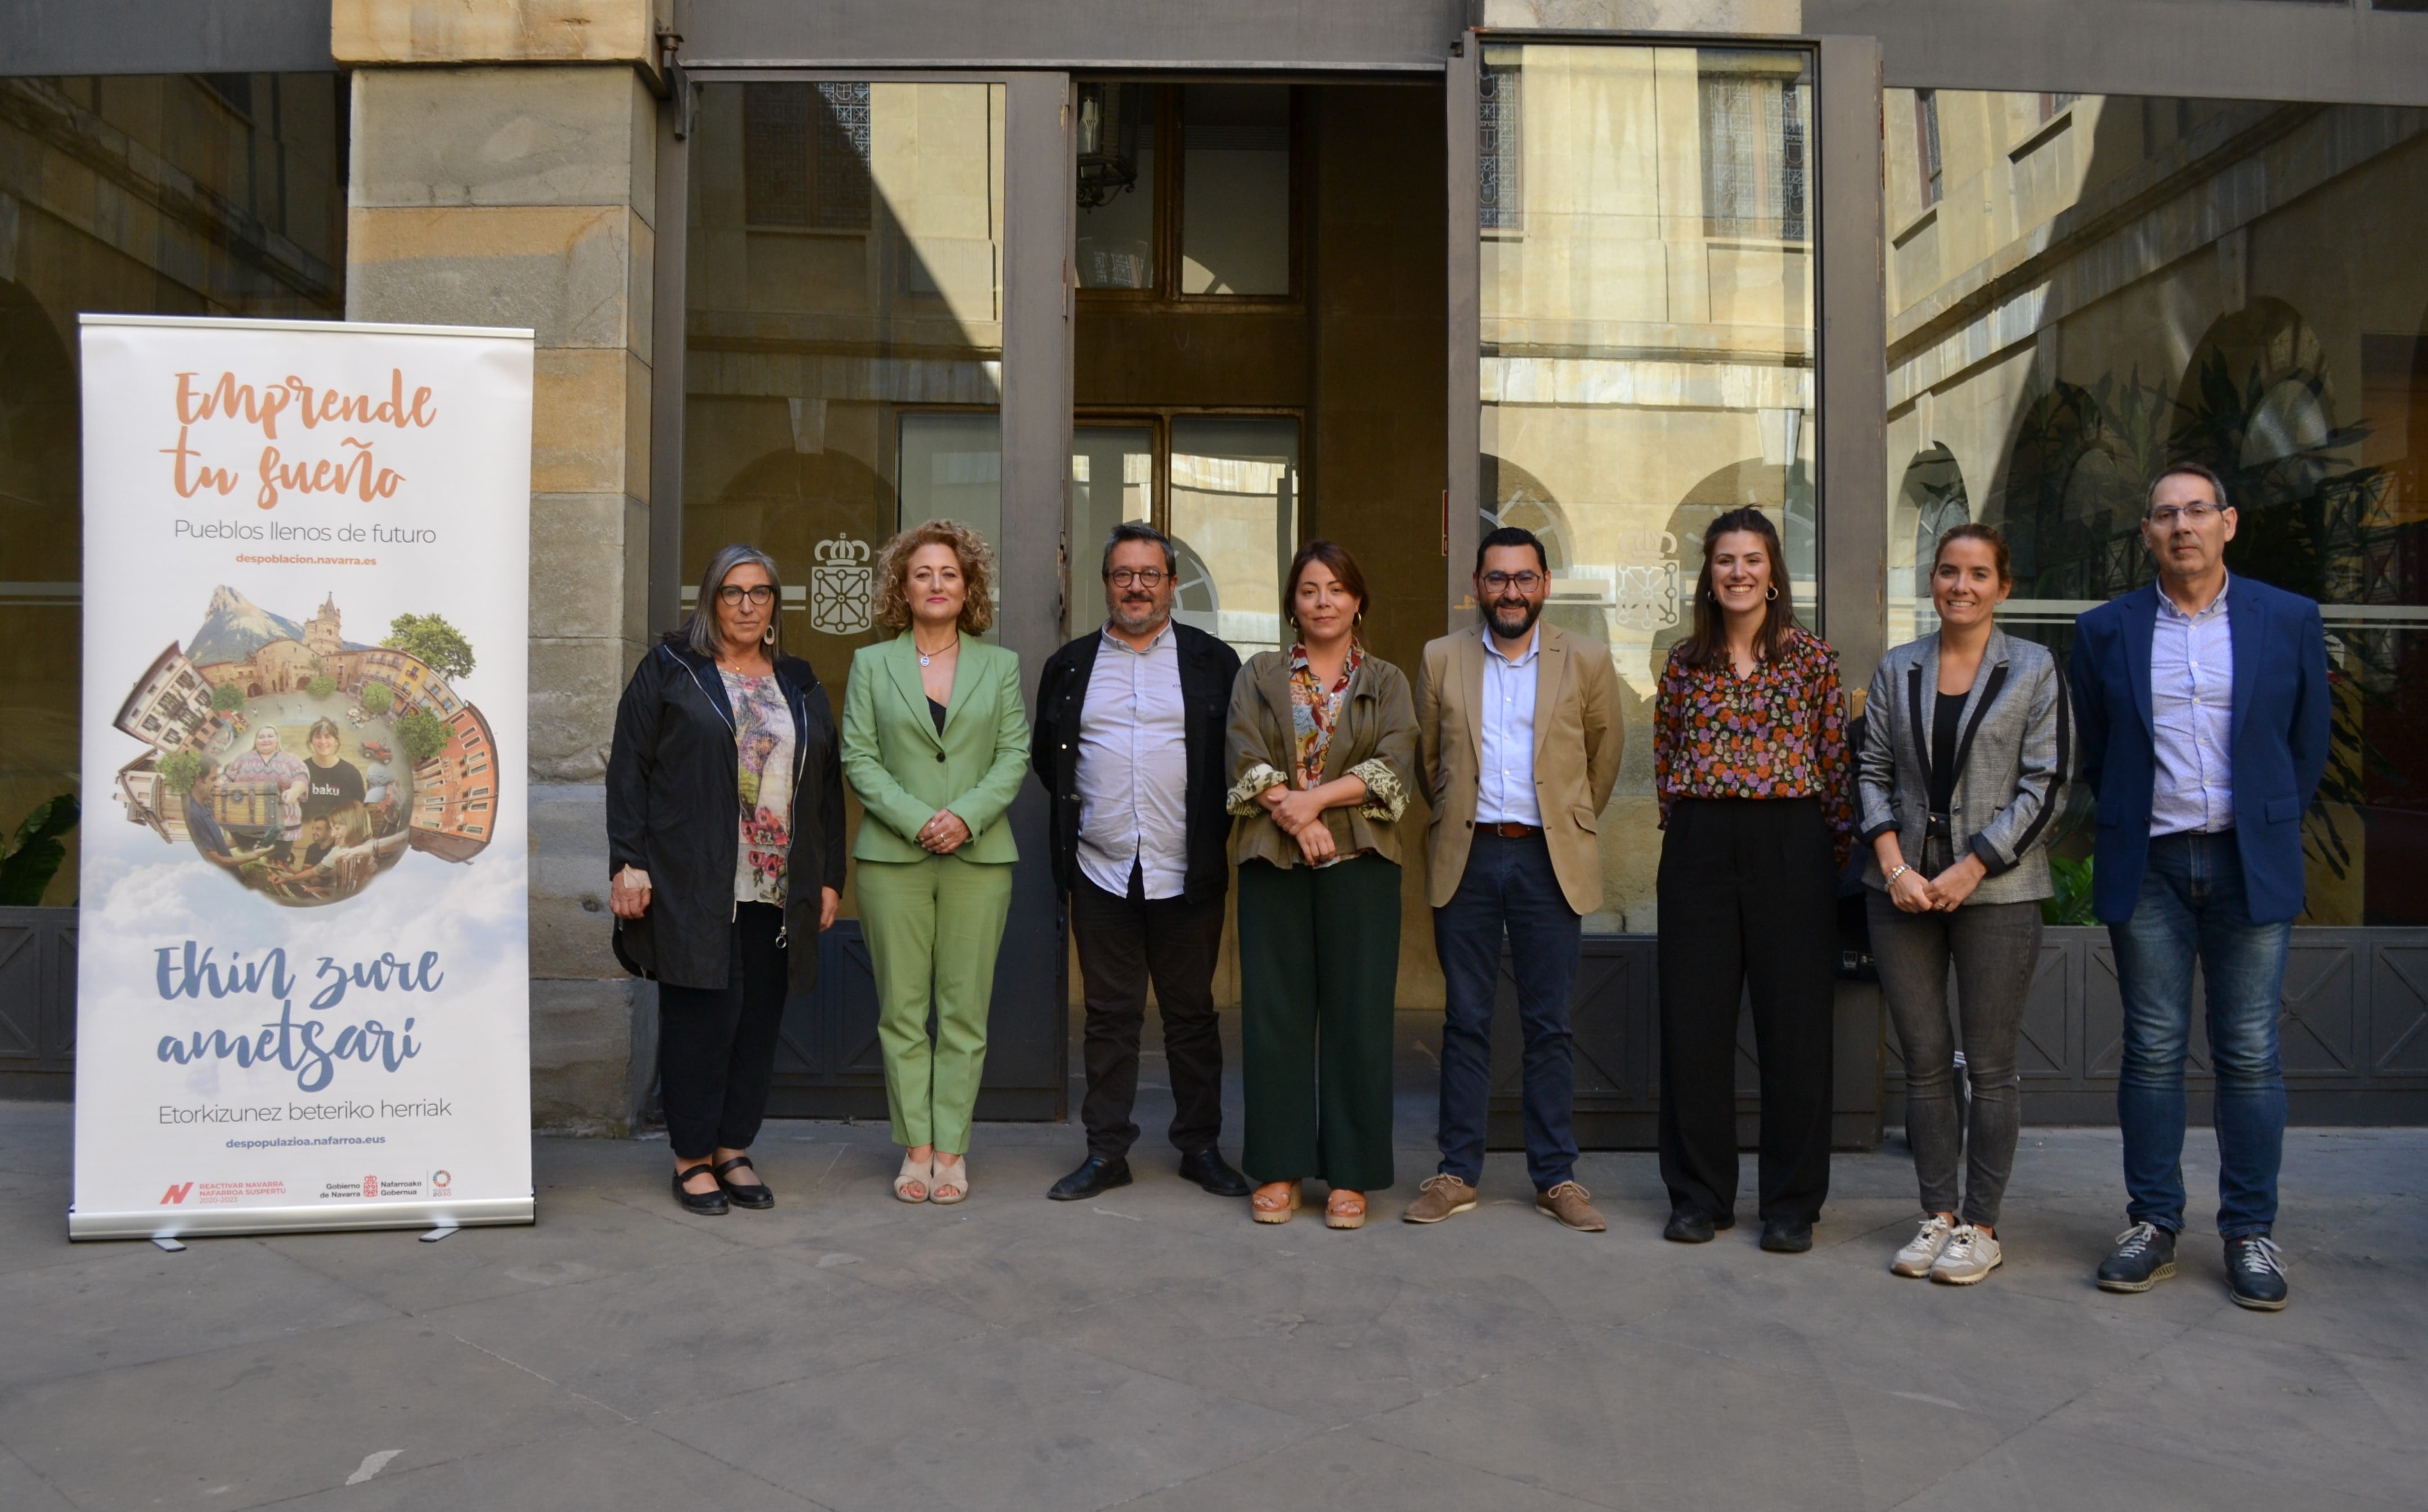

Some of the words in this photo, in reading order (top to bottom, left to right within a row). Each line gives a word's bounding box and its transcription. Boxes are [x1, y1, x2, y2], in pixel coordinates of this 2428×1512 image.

[175, 369, 437, 439] Emprende
[159, 426, 239, 499] tu
[258, 437, 406, 510] sueño
[175, 519, 264, 540] Pueblos
[270, 522, 332, 542] llenos
[337, 523, 366, 542] de
[371, 523, 437, 544] futuro
[236, 553, 377, 566] despoblacion.navarra.es
[312, 783, 340, 796] baku
[154, 940, 297, 1000] Ekin
[309, 950, 444, 1010] zure
[157, 999, 421, 1093] ametsari
[159, 1103, 282, 1125] Etorkizunez
[289, 1100, 375, 1121] beteriko
[380, 1098, 452, 1118] herriak
[225, 1133, 386, 1150] despopulazioa.nafarroa.eus
